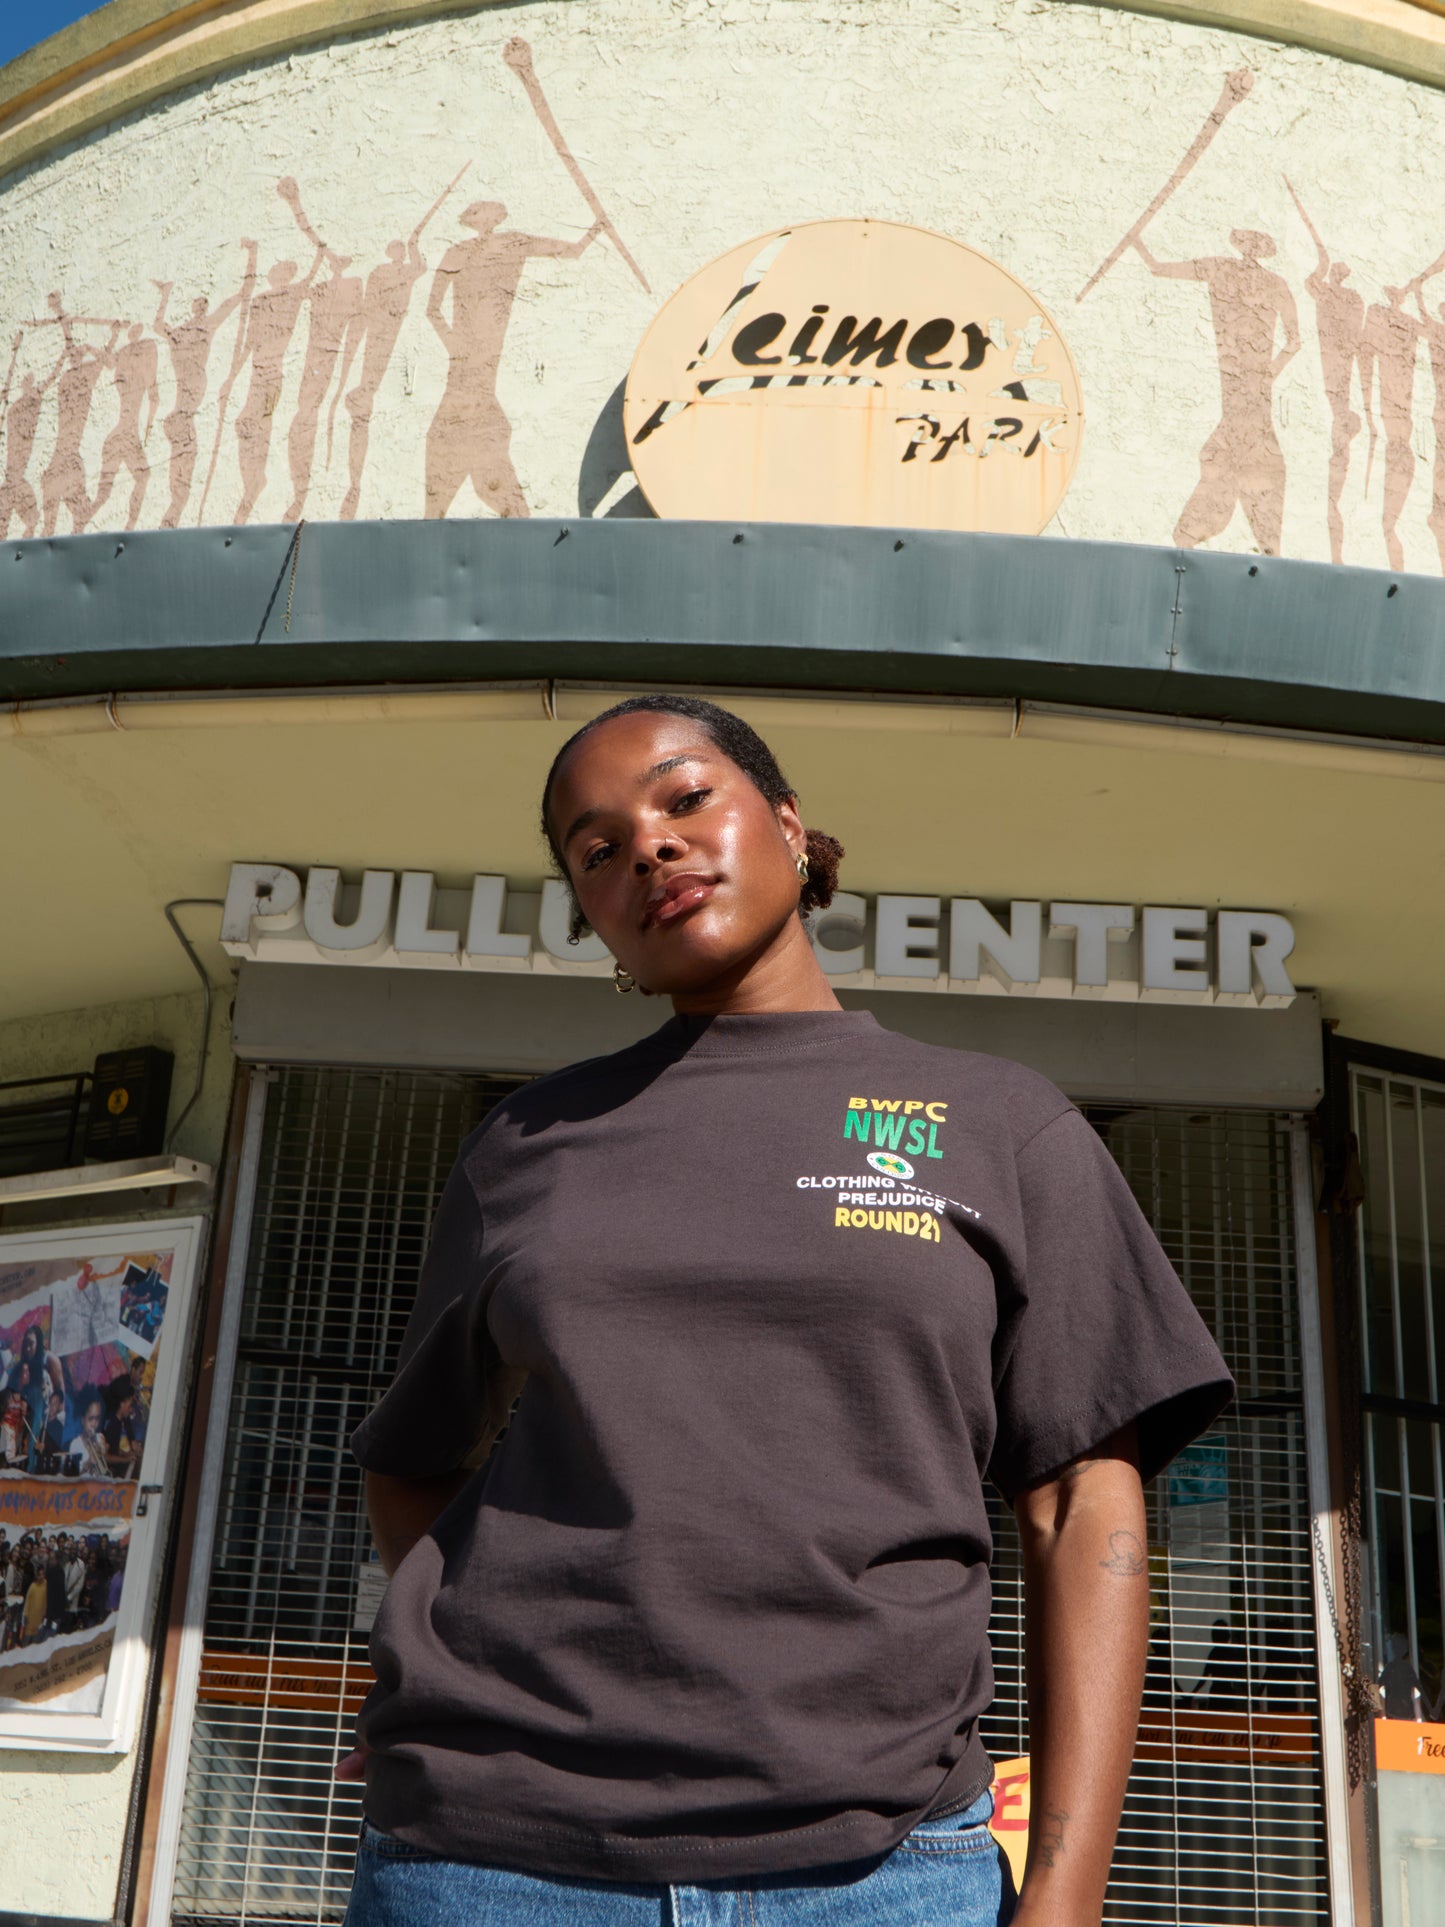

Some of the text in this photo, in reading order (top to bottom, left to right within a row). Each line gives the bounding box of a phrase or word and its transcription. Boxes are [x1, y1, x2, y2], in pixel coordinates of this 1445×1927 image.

[895, 413, 1070, 463] PARK
[219, 862, 1297, 1004] PULLU CENTER
[848, 1097, 948, 1122] BWPC
[843, 1110, 944, 1159] NWSL
[796, 1175, 895, 1189] CLOTHING
[838, 1192, 946, 1215] PREJUDICE
[834, 1207, 941, 1243] ROUND21
